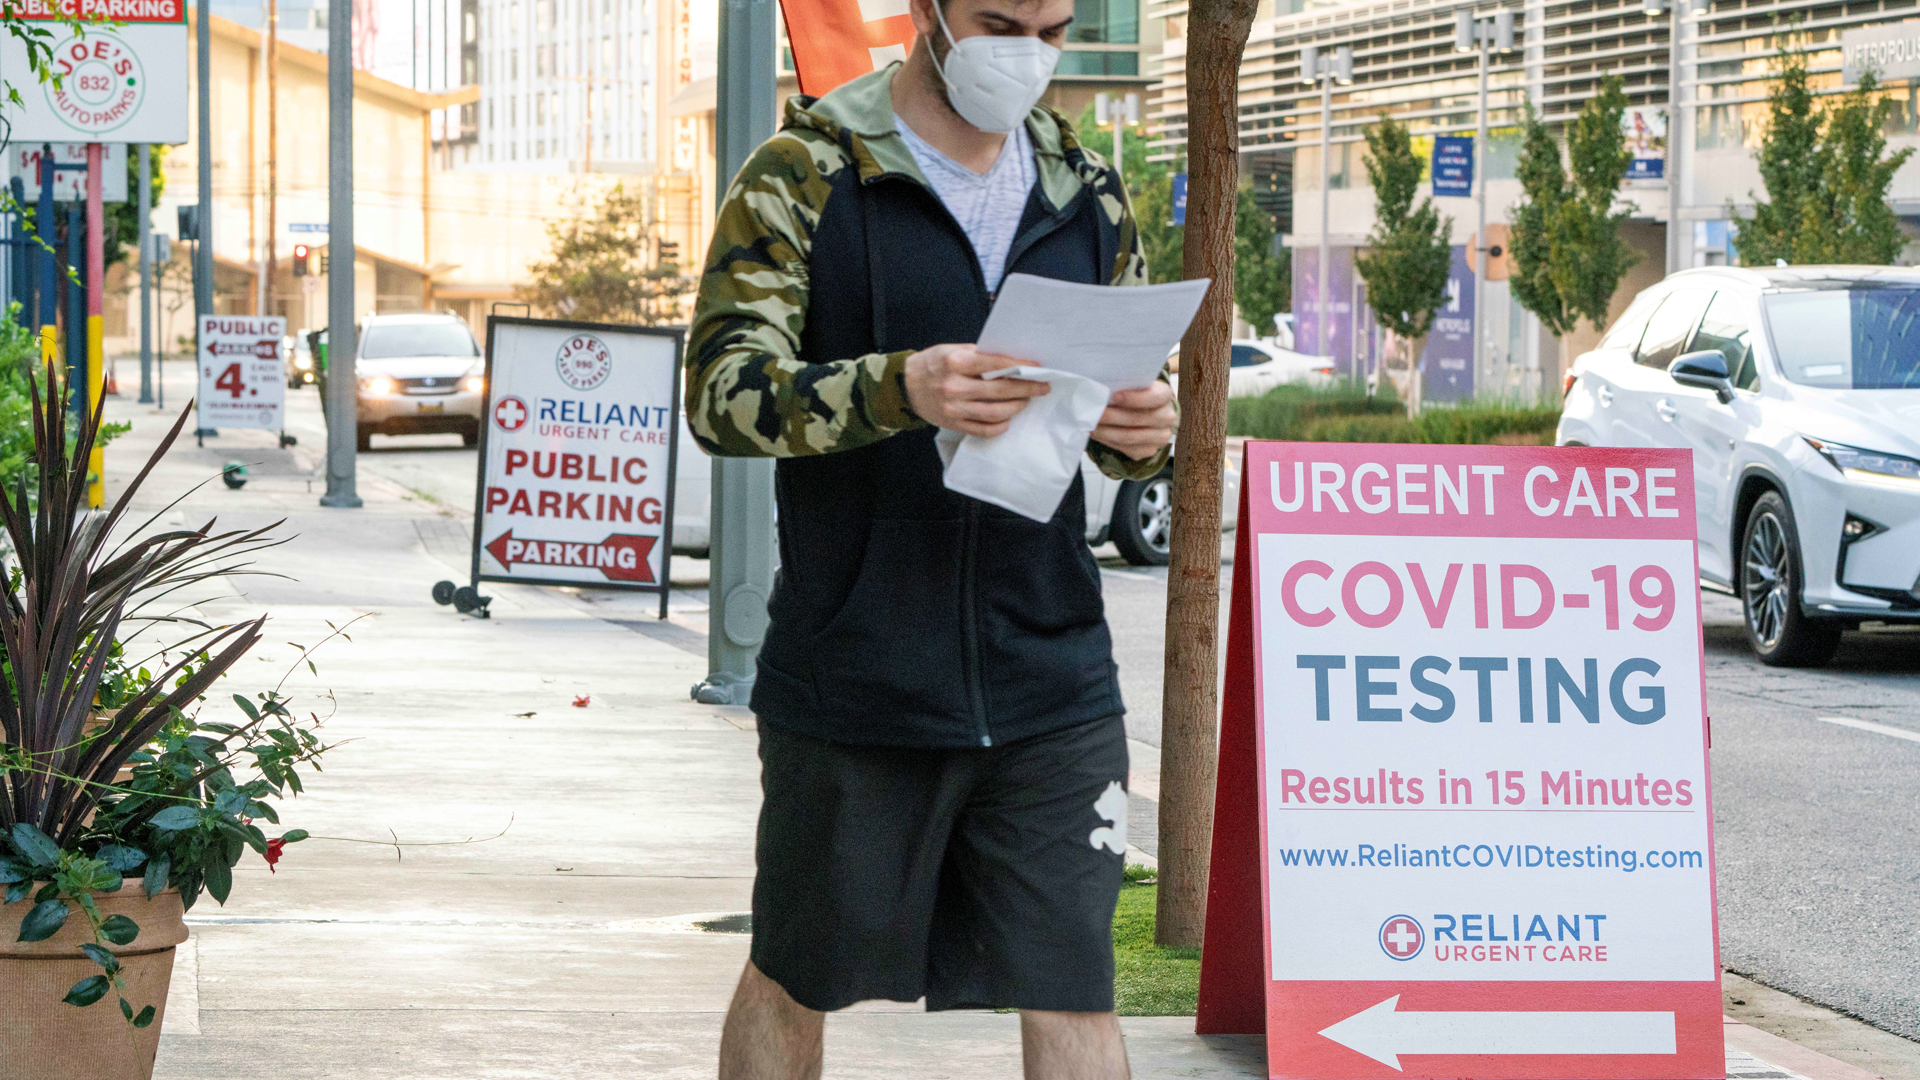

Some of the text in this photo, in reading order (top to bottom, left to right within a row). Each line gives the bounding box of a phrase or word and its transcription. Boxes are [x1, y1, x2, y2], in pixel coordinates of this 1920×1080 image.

[0, 0, 176, 17] UBLC PARKING
[57, 41, 133, 77] JOE'S
[80, 76, 110, 91] 832
[54, 89, 136, 125] AUTO PARKS
[206, 320, 279, 335] PUBLIC
[564, 338, 608, 362] JOE'S
[540, 398, 669, 430] RELIANT
[539, 424, 668, 446] URGENT CARE
[505, 448, 648, 485] PUBLIC
[1269, 461, 1680, 519] URGENT CARE
[486, 486, 662, 526] PARKING
[505, 539, 637, 570] PARKING
[1280, 559, 1676, 632] COVID-19
[1296, 653, 1667, 726] TESTING
[1279, 768, 1694, 807] Results in 15 Minutes
[1279, 843, 1703, 873] www.ReliantCOVIDtesting.com
[1433, 914, 1607, 942] RELIANT
[1434, 945, 1608, 962] URGENT CARE
